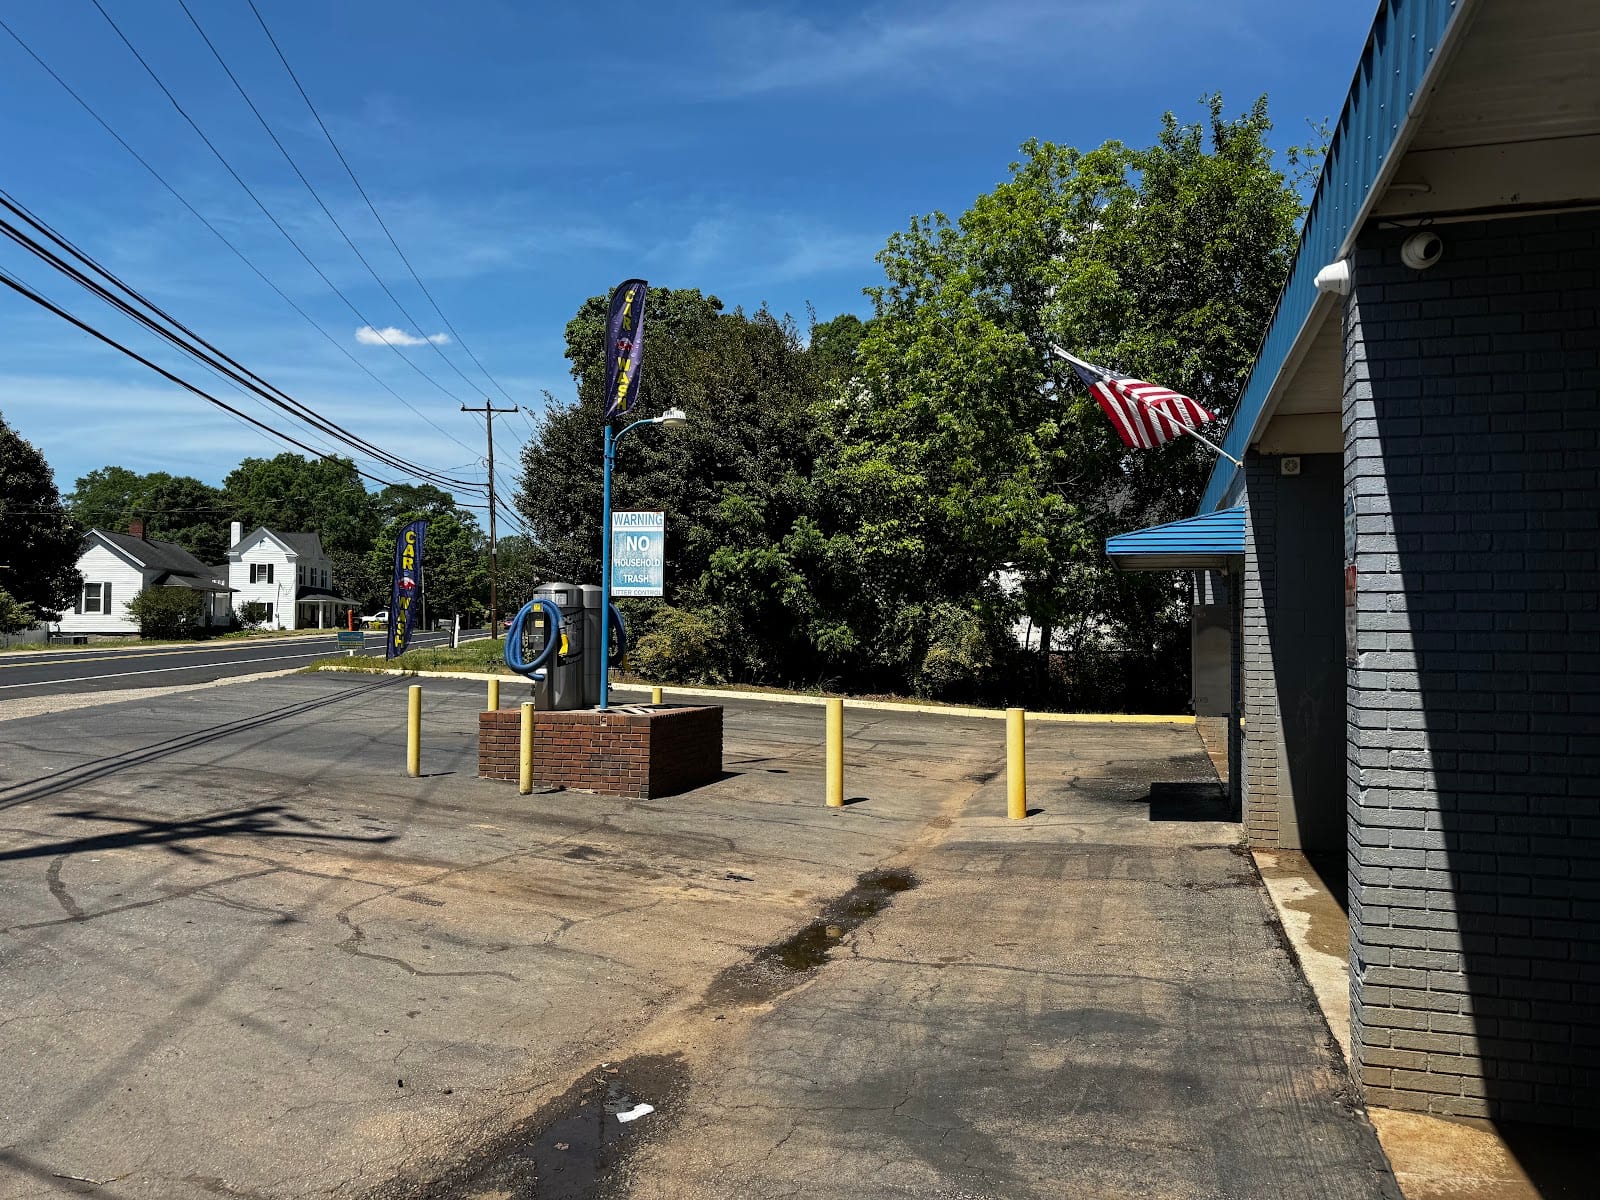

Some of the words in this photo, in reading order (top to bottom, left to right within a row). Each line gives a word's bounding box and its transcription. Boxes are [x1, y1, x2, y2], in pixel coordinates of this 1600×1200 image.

[623, 289, 635, 331] CAR
[617, 356, 631, 411] WASH
[613, 513, 663, 526] WARNING
[403, 531, 416, 571] CAR
[626, 535, 650, 552] NO
[614, 558, 660, 567] HOUSEHOLD
[623, 574, 649, 583] TRASH
[394, 596, 411, 648] WASH
